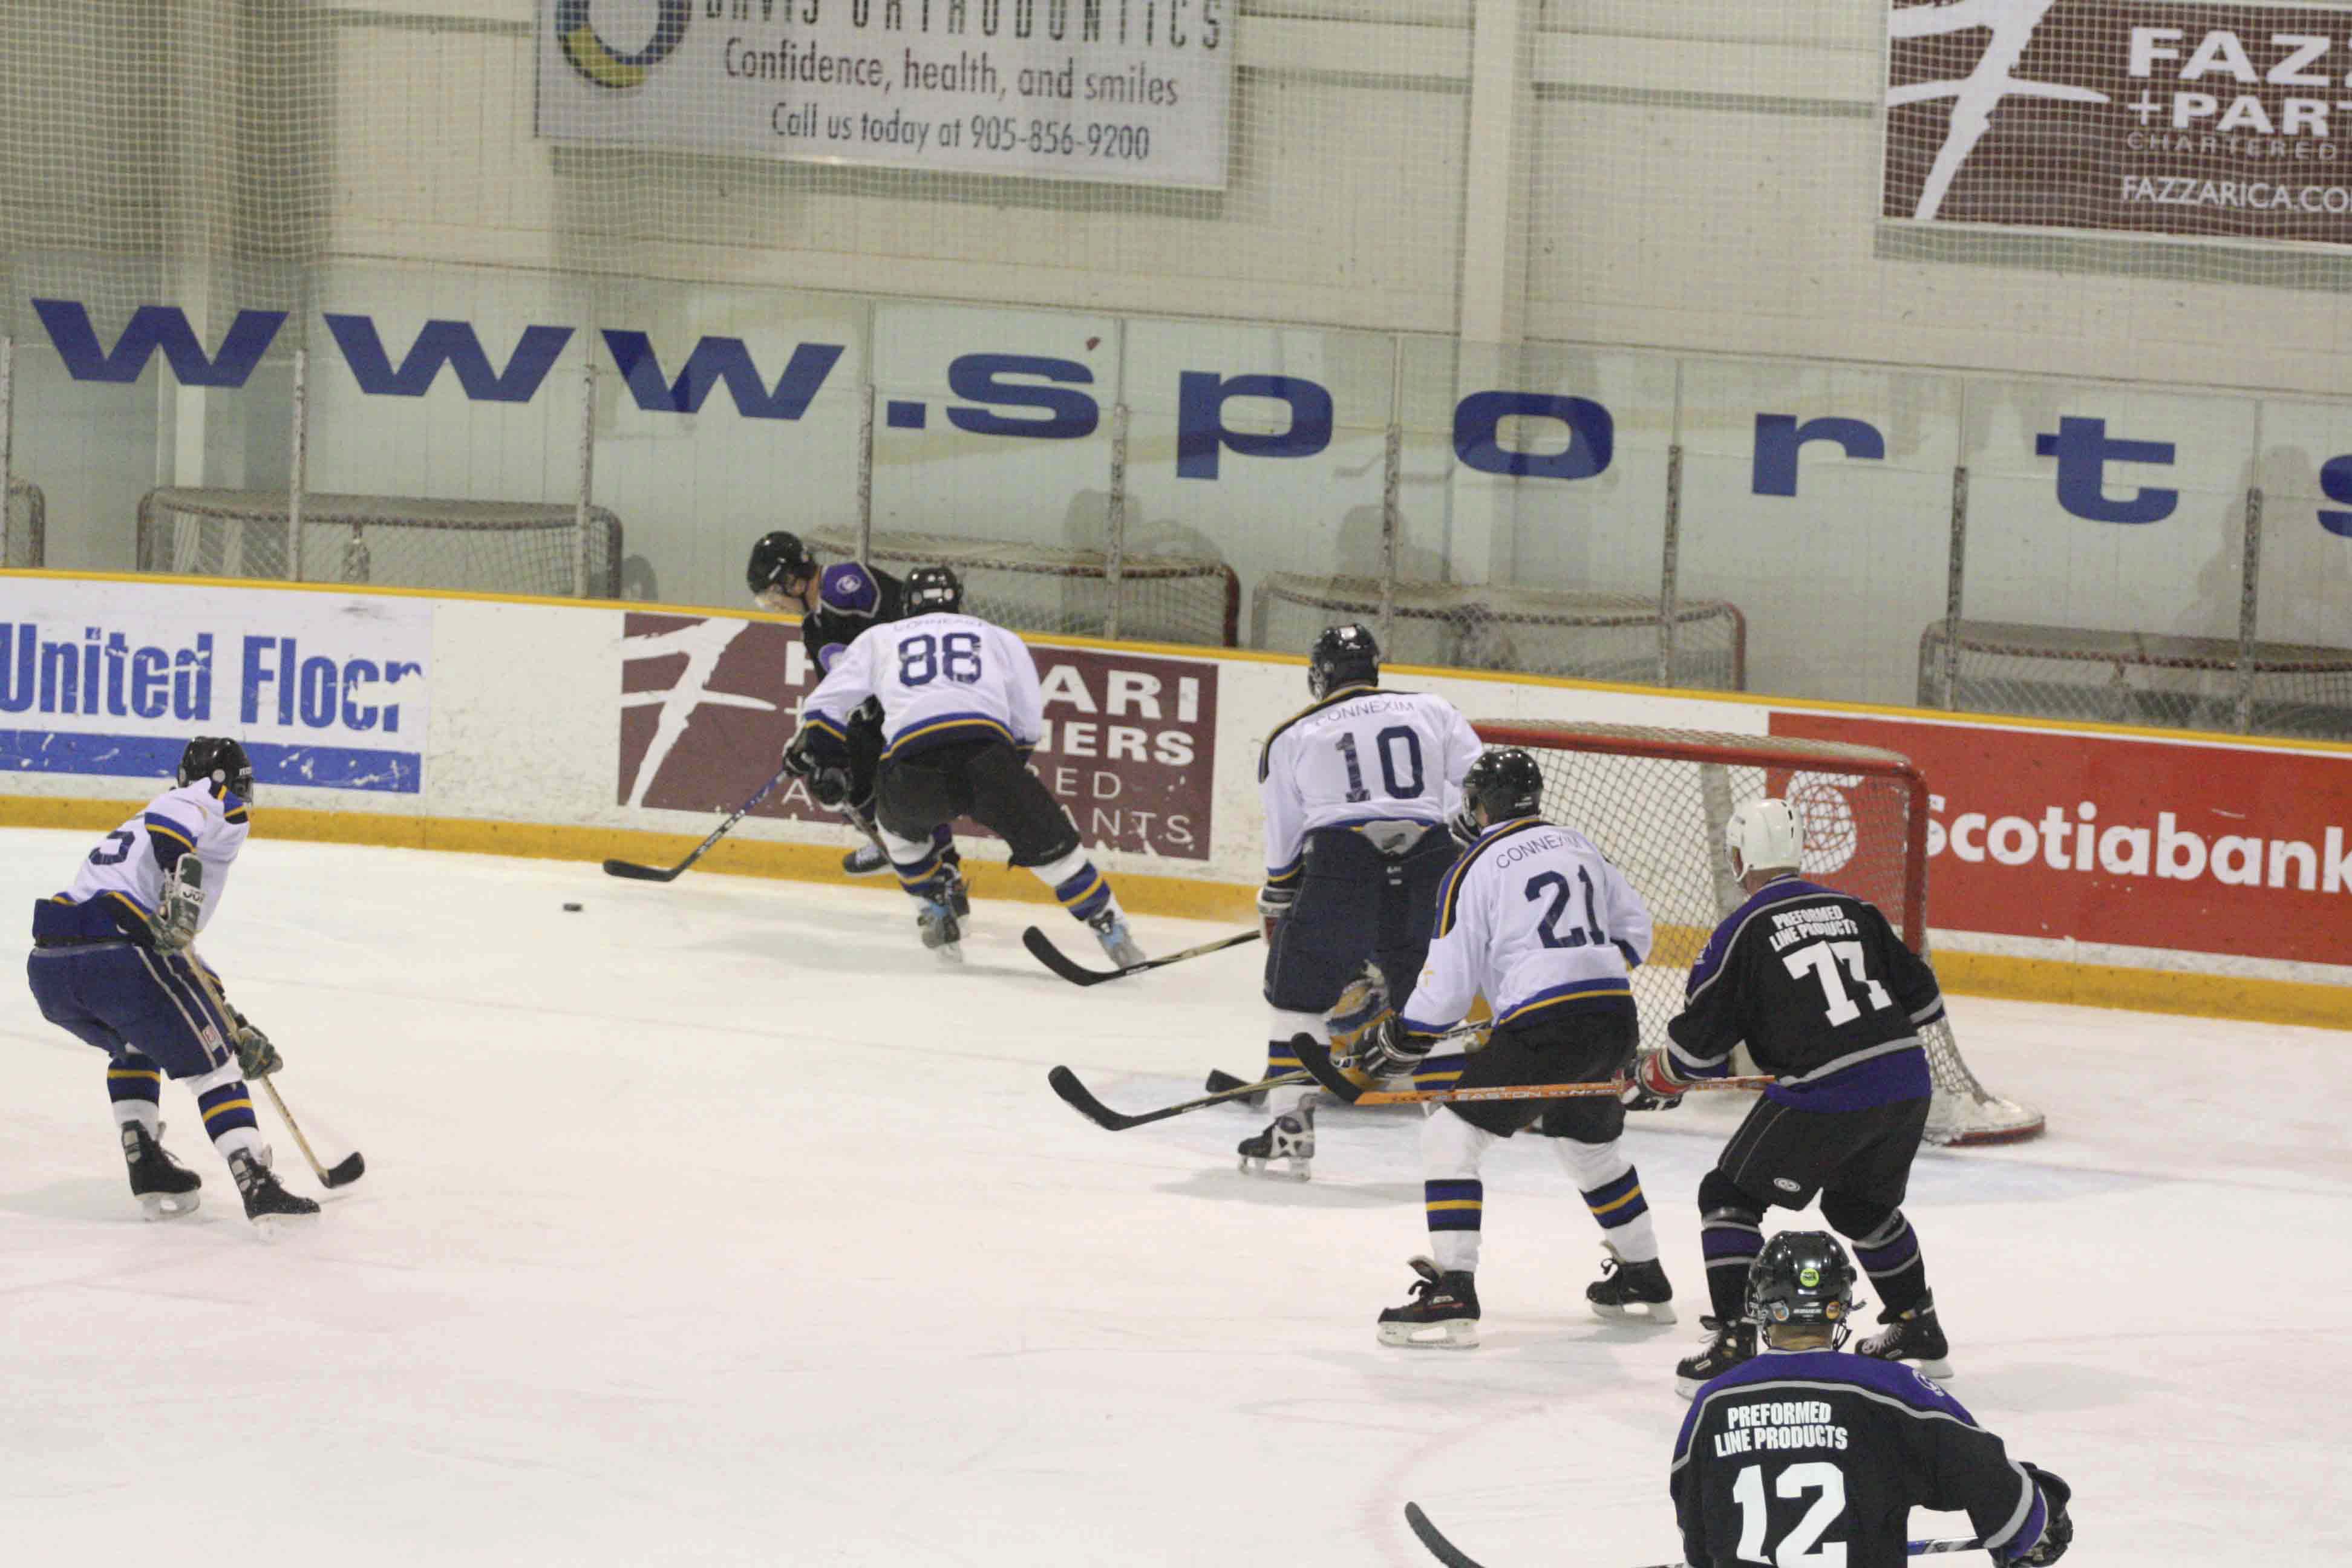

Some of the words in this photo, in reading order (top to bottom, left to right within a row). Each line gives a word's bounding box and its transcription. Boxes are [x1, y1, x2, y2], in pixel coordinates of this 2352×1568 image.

[725, 36, 893, 95] Confidence,
[903, 47, 1007, 102] health,
[1017, 57, 1073, 99] and
[1084, 61, 1178, 106] smiles
[2129, 26, 2352, 88] FAZ
[771, 102, 817, 138] Call
[827, 114, 852, 140] us
[861, 108, 930, 154] today
[938, 118, 962, 148] at
[970, 114, 1149, 160] 905-856-9200
[2128, 91, 2352, 137] +PAR
[2127, 131, 2337, 161] CHARTERED
[2122, 174, 2352, 212] FAZZARICA.CO
[0, 622, 214, 720] United
[1335, 725, 1425, 803] 10
[1524, 864, 1605, 949] 21
[1771, 904, 1844, 930] PREFORMED
[1768, 926, 1801, 953] LINE
[1714, 1428, 1752, 1457] LINE
[1754, 1424, 1849, 1450] PRODUCTS
[1727, 1400, 1832, 1429] PREFORMED
[1732, 1462, 1847, 1568] 12
